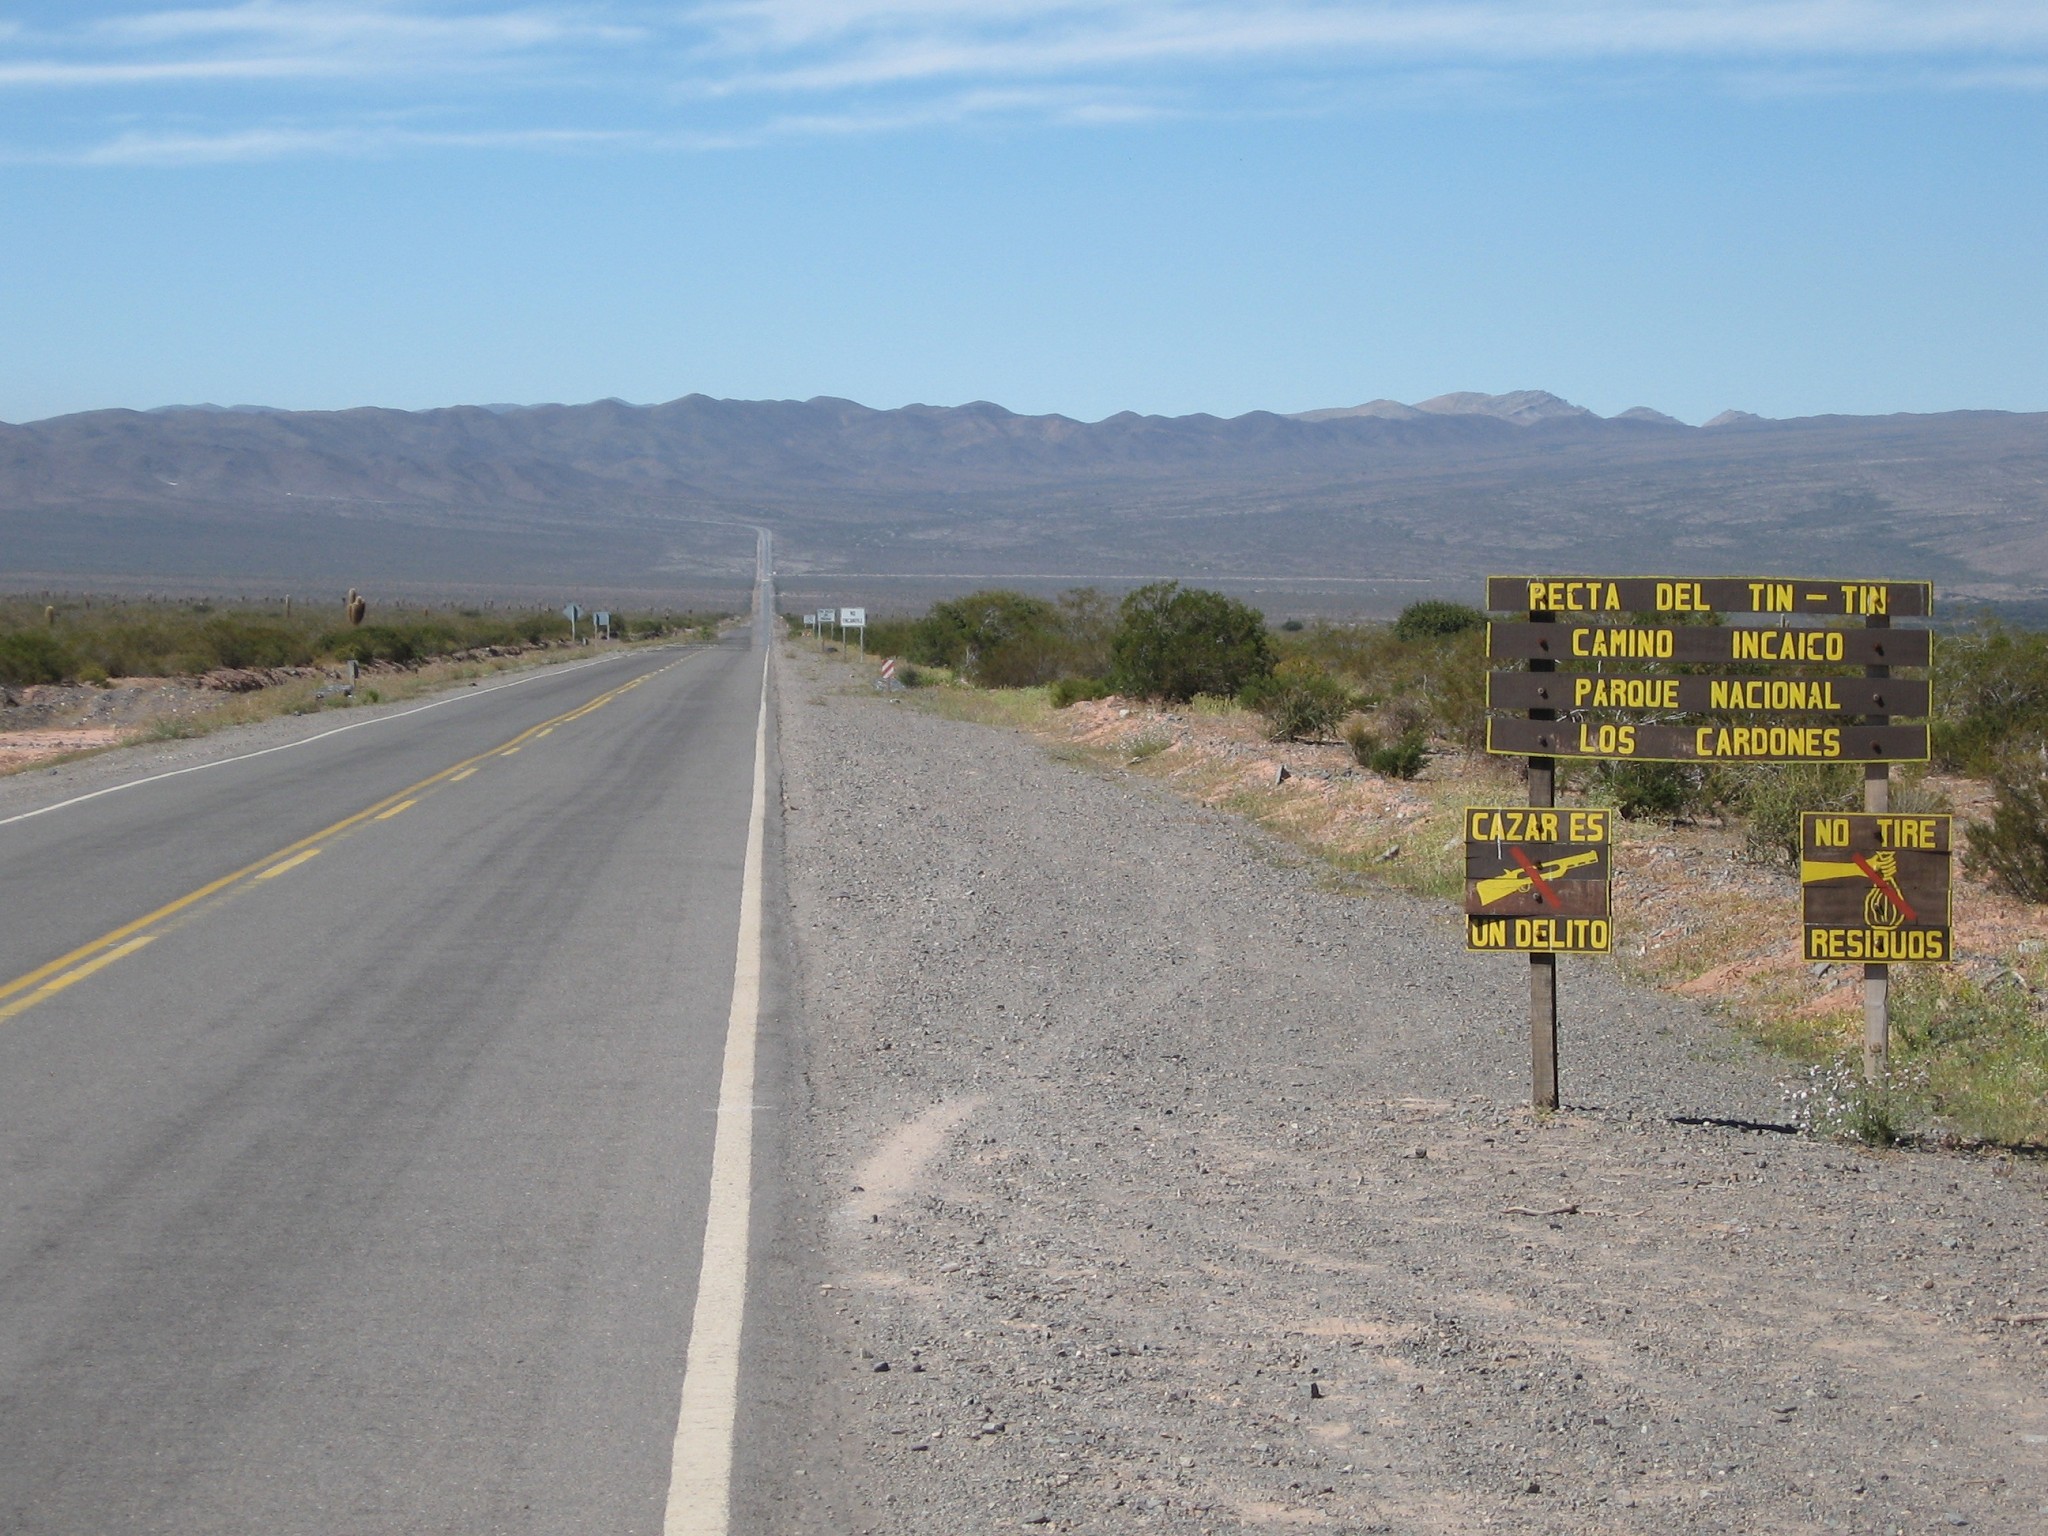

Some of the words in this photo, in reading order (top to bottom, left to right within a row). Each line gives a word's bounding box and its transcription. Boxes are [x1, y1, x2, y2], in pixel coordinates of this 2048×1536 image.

[1530, 583, 1620, 611] RECTA
[1656, 583, 1710, 611] DEL
[1573, 629, 1673, 657] CAMINO
[1733, 631, 1844, 660] INCAICO
[1575, 679, 1679, 708] PARQUE
[1711, 681, 1841, 710] NACIONAL
[1580, 724, 1635, 754] LOS
[1697, 728, 1841, 757] CARDONES
[1472, 813, 1558, 842] CAZAR
[1570, 813, 1604, 842] ES
[1815, 819, 1850, 847] NO
[1877, 819, 1937, 848] TIRE
[1472, 920, 1506, 948] UN
[1516, 919, 1608, 950] DELITO
[1811, 930, 1943, 960] RESIDUOS
